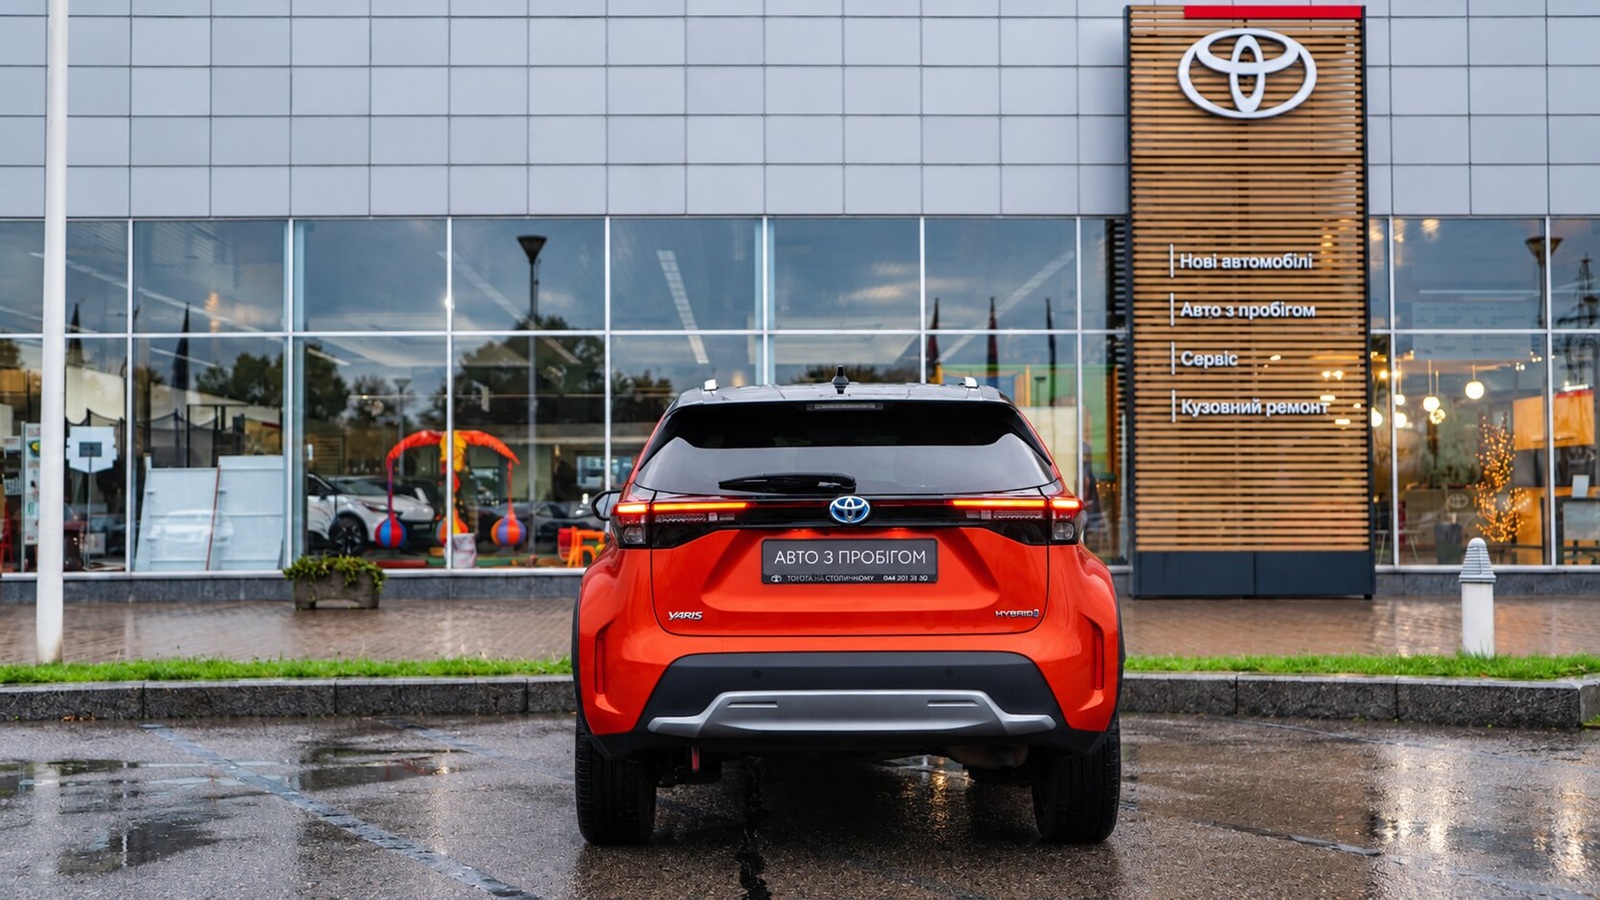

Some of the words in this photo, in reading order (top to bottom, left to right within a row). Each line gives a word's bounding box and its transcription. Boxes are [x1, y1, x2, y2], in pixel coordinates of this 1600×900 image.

[1180, 253, 1217, 269] Нові
[1221, 253, 1313, 269] автомобілі
[1180, 302, 1221, 317] Авто
[1225, 304, 1235, 317] з
[1238, 301, 1316, 320] пробігом
[1180, 350, 1239, 369] Сервіс
[1181, 398, 1262, 417] Кузовний
[1266, 401, 1329, 417] ремонт
[774, 550, 819, 564] АВТО
[823, 550, 834, 564] З
[838, 550, 926, 564] ПРОБІГОМ
[883, 574, 896, 582] 044
[896, 574, 908, 582] 201
[668, 611, 703, 621] YARIS
